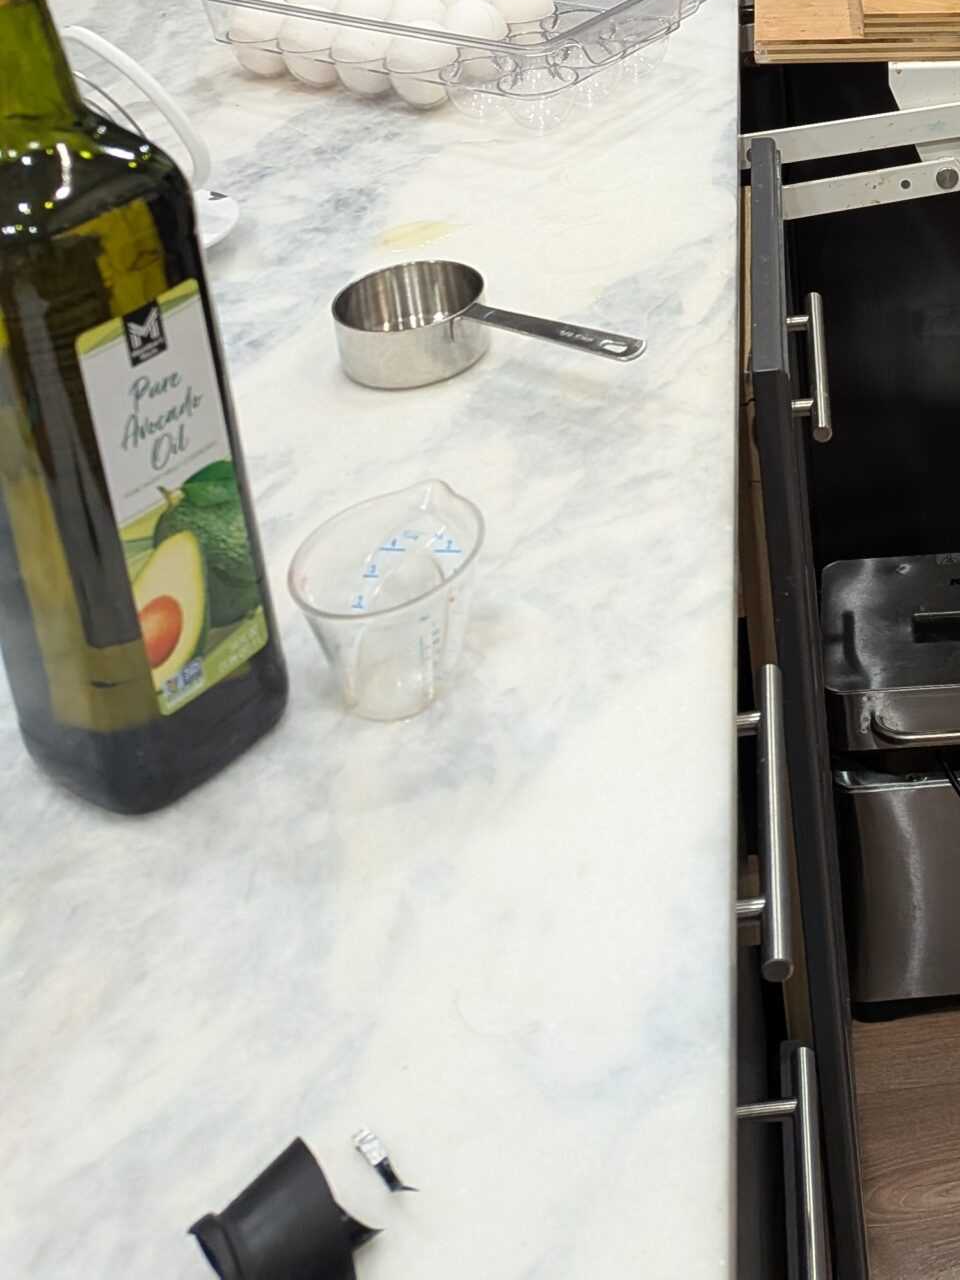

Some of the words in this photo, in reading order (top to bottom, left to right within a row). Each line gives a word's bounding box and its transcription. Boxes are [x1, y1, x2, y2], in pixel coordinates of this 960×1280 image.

[130, 371, 181, 412] Pure
[121, 386, 204, 451] Avocado
[150, 425, 189, 471] Oil
